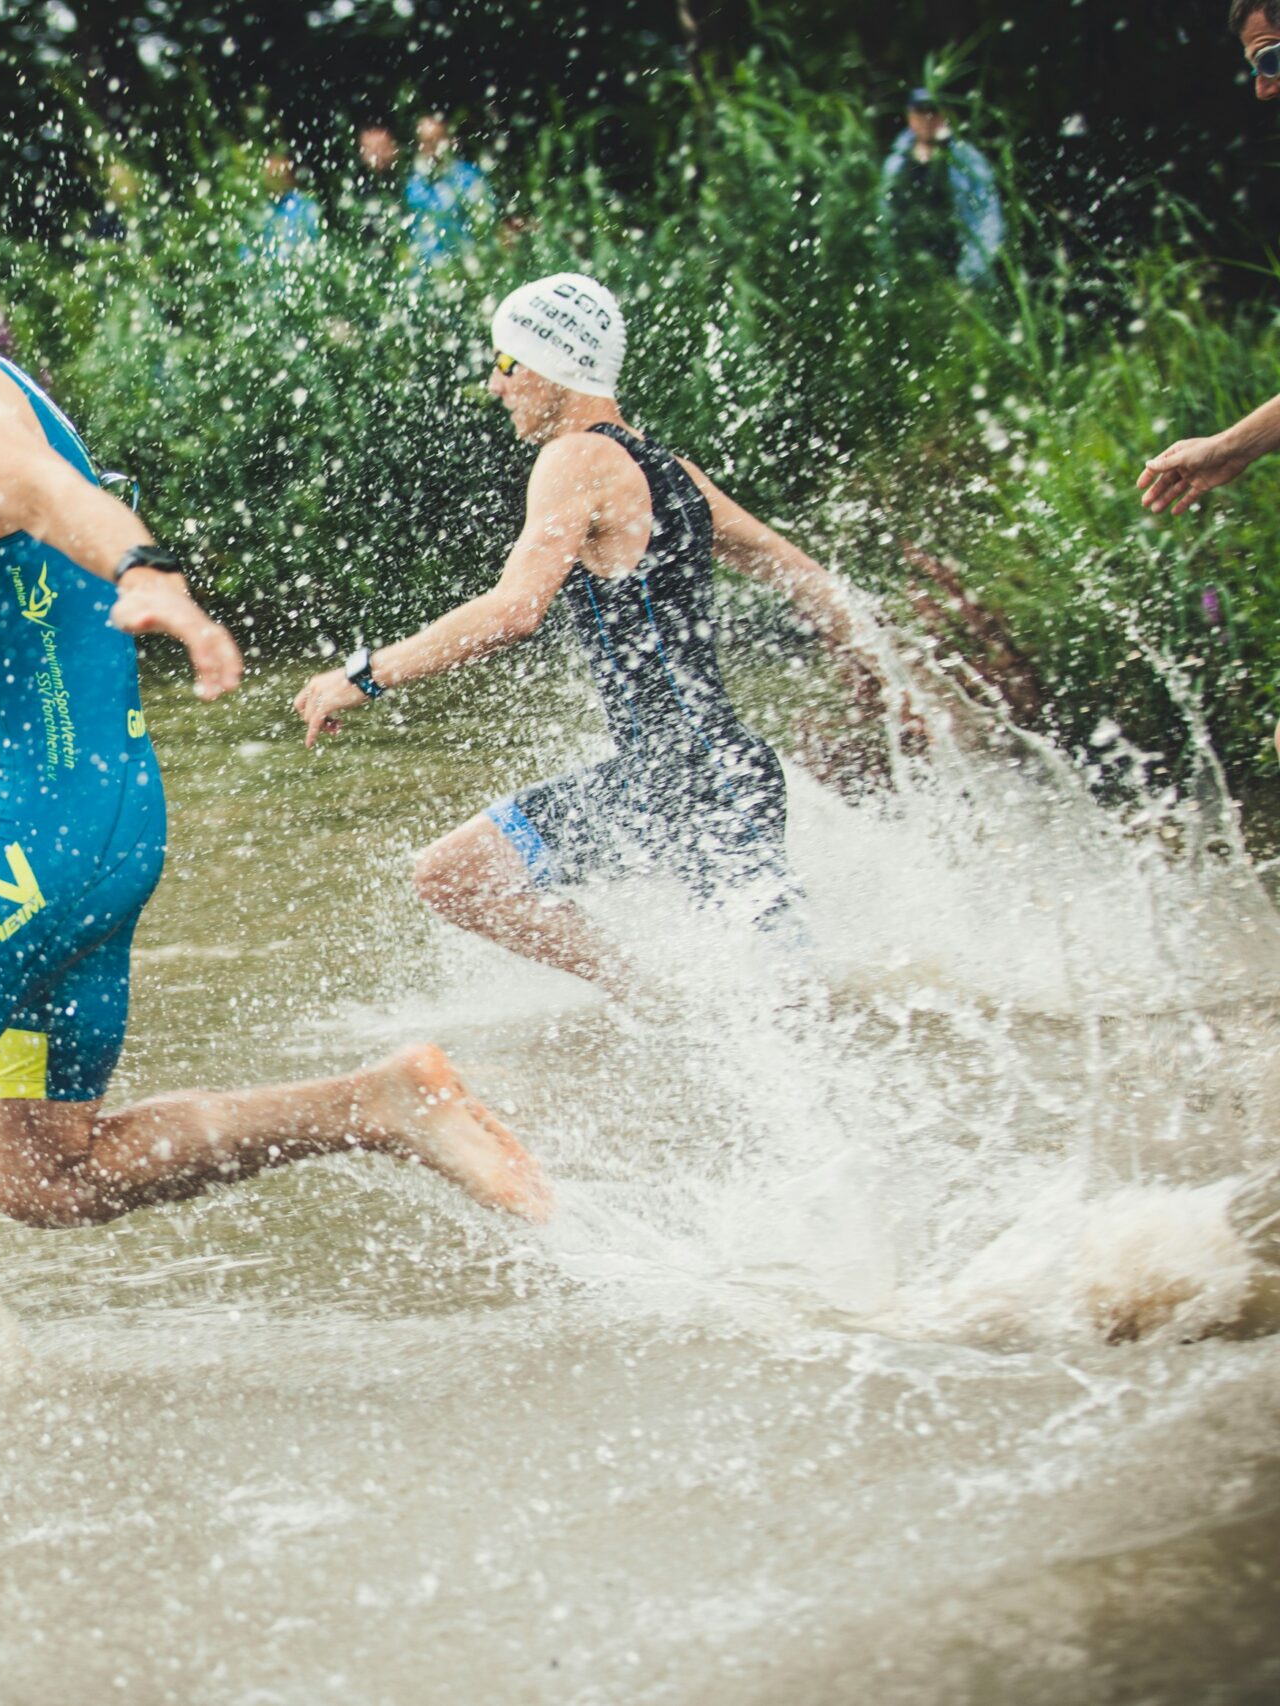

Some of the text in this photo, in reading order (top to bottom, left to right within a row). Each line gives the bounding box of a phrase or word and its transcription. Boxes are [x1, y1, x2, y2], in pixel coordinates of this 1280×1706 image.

[11, 566, 27, 606] Triathlon
[35, 671, 54, 696] SSV
[41, 698, 60, 765] Forchheim
